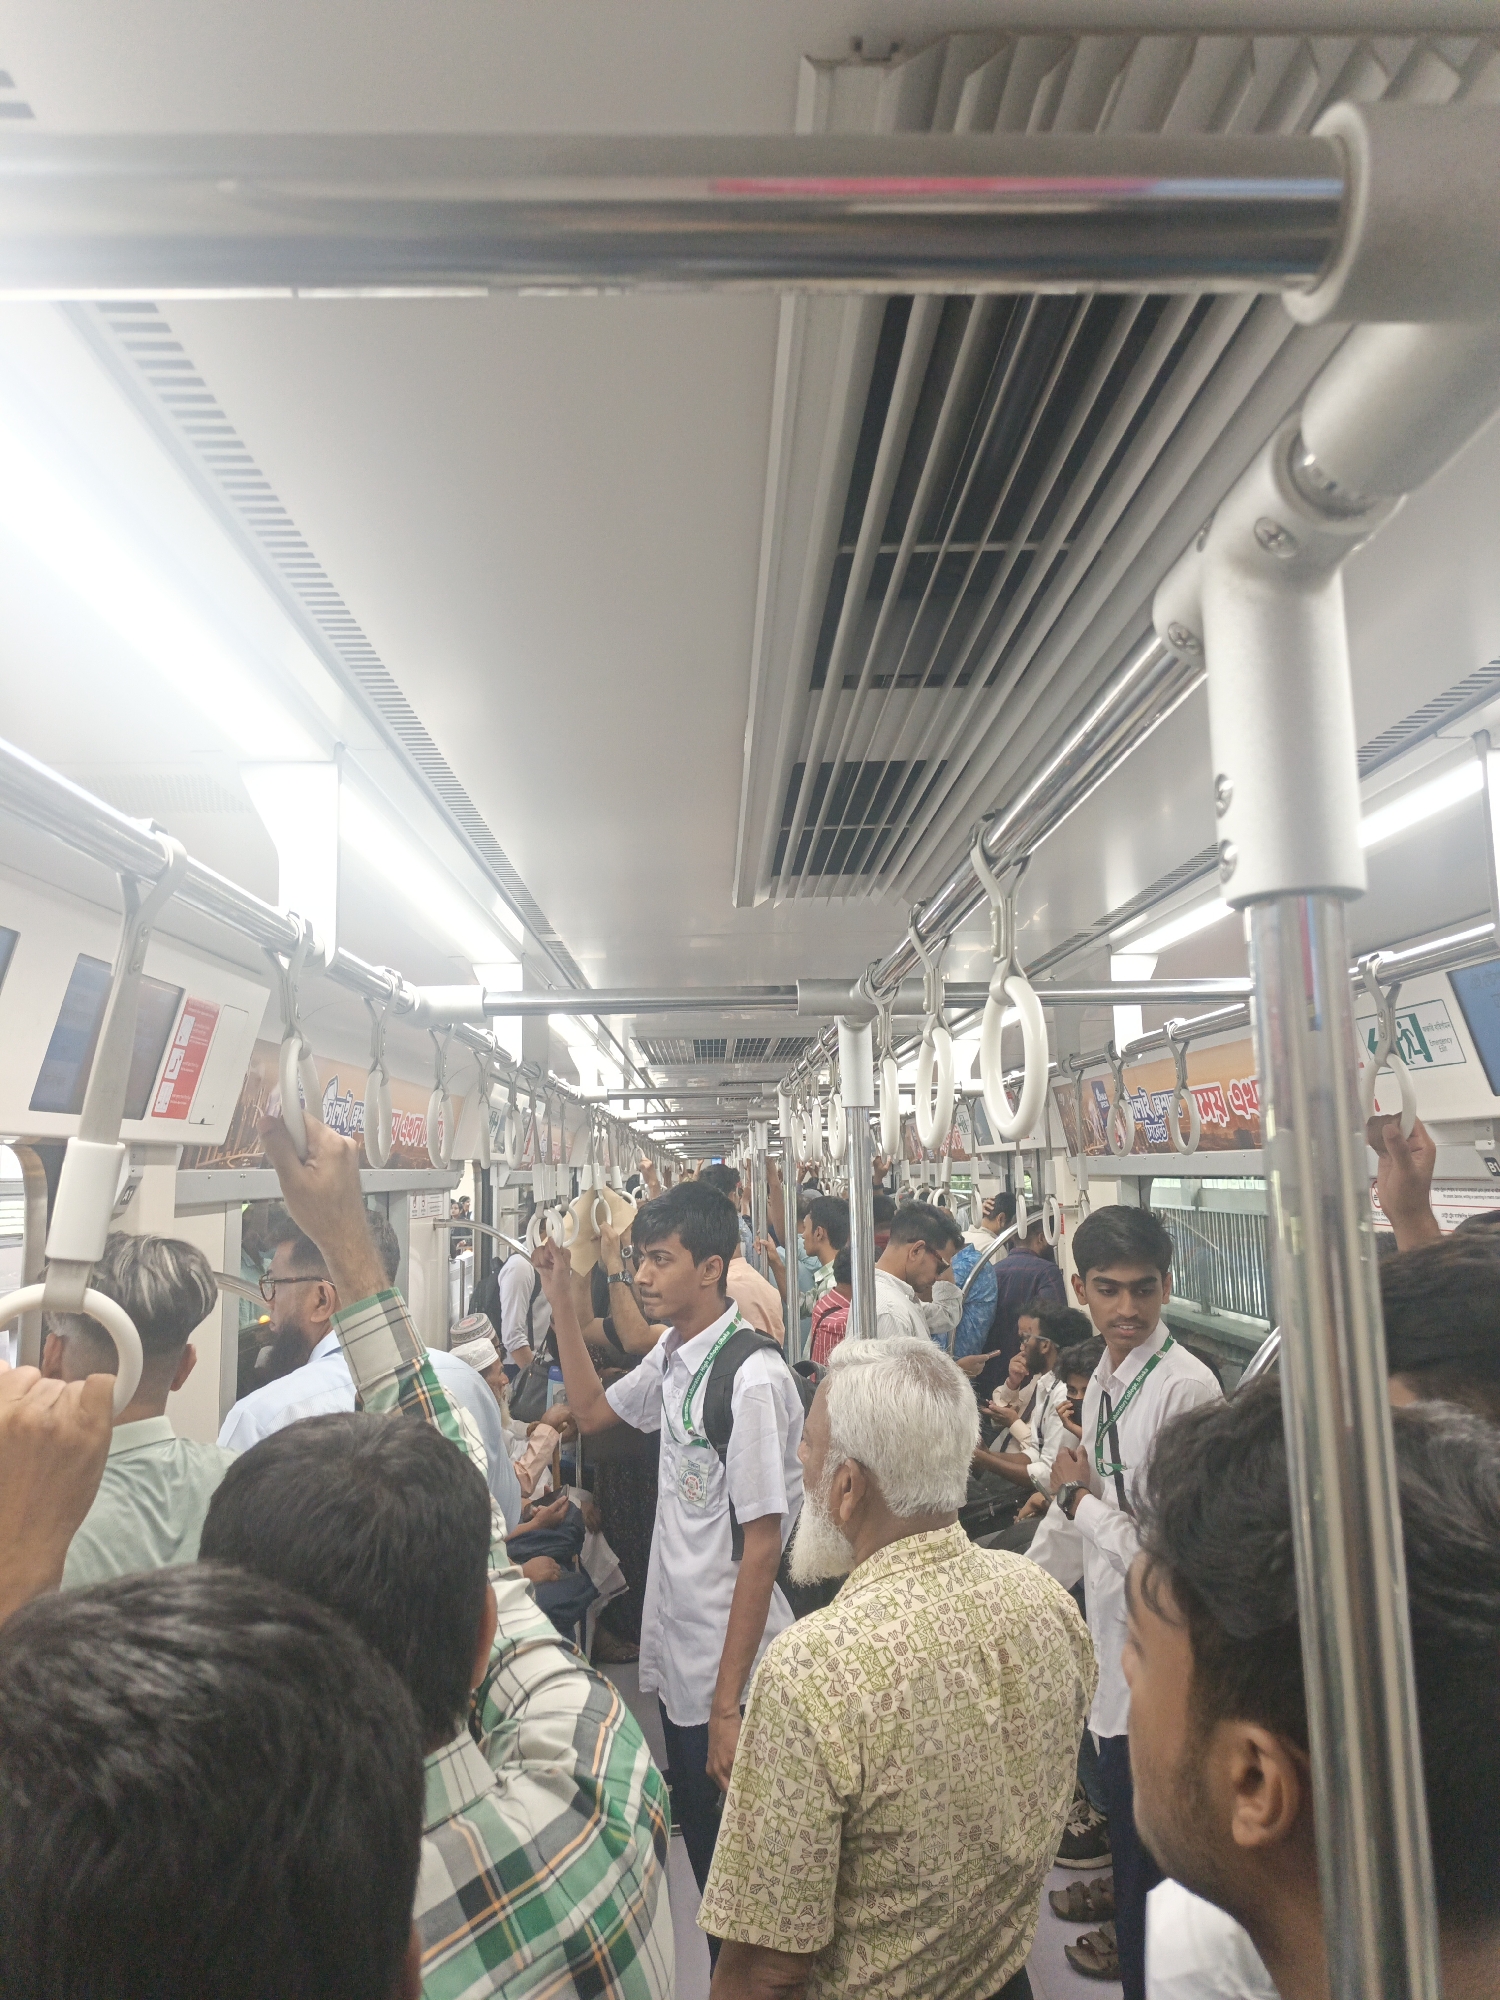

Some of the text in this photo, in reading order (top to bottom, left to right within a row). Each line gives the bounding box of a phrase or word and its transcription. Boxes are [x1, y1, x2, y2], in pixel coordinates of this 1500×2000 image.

[688, 1372, 703, 1398] Laboratory
[700, 1360, 710, 1374] High
[707, 1344, 720, 1361] School,
[718, 1331, 730, 1345] Dhaka
[1111, 1401, 1127, 1422] Laboratory
[1125, 1382, 1139, 1400] College,
[1135, 1368, 1149, 1382] Dhaka
